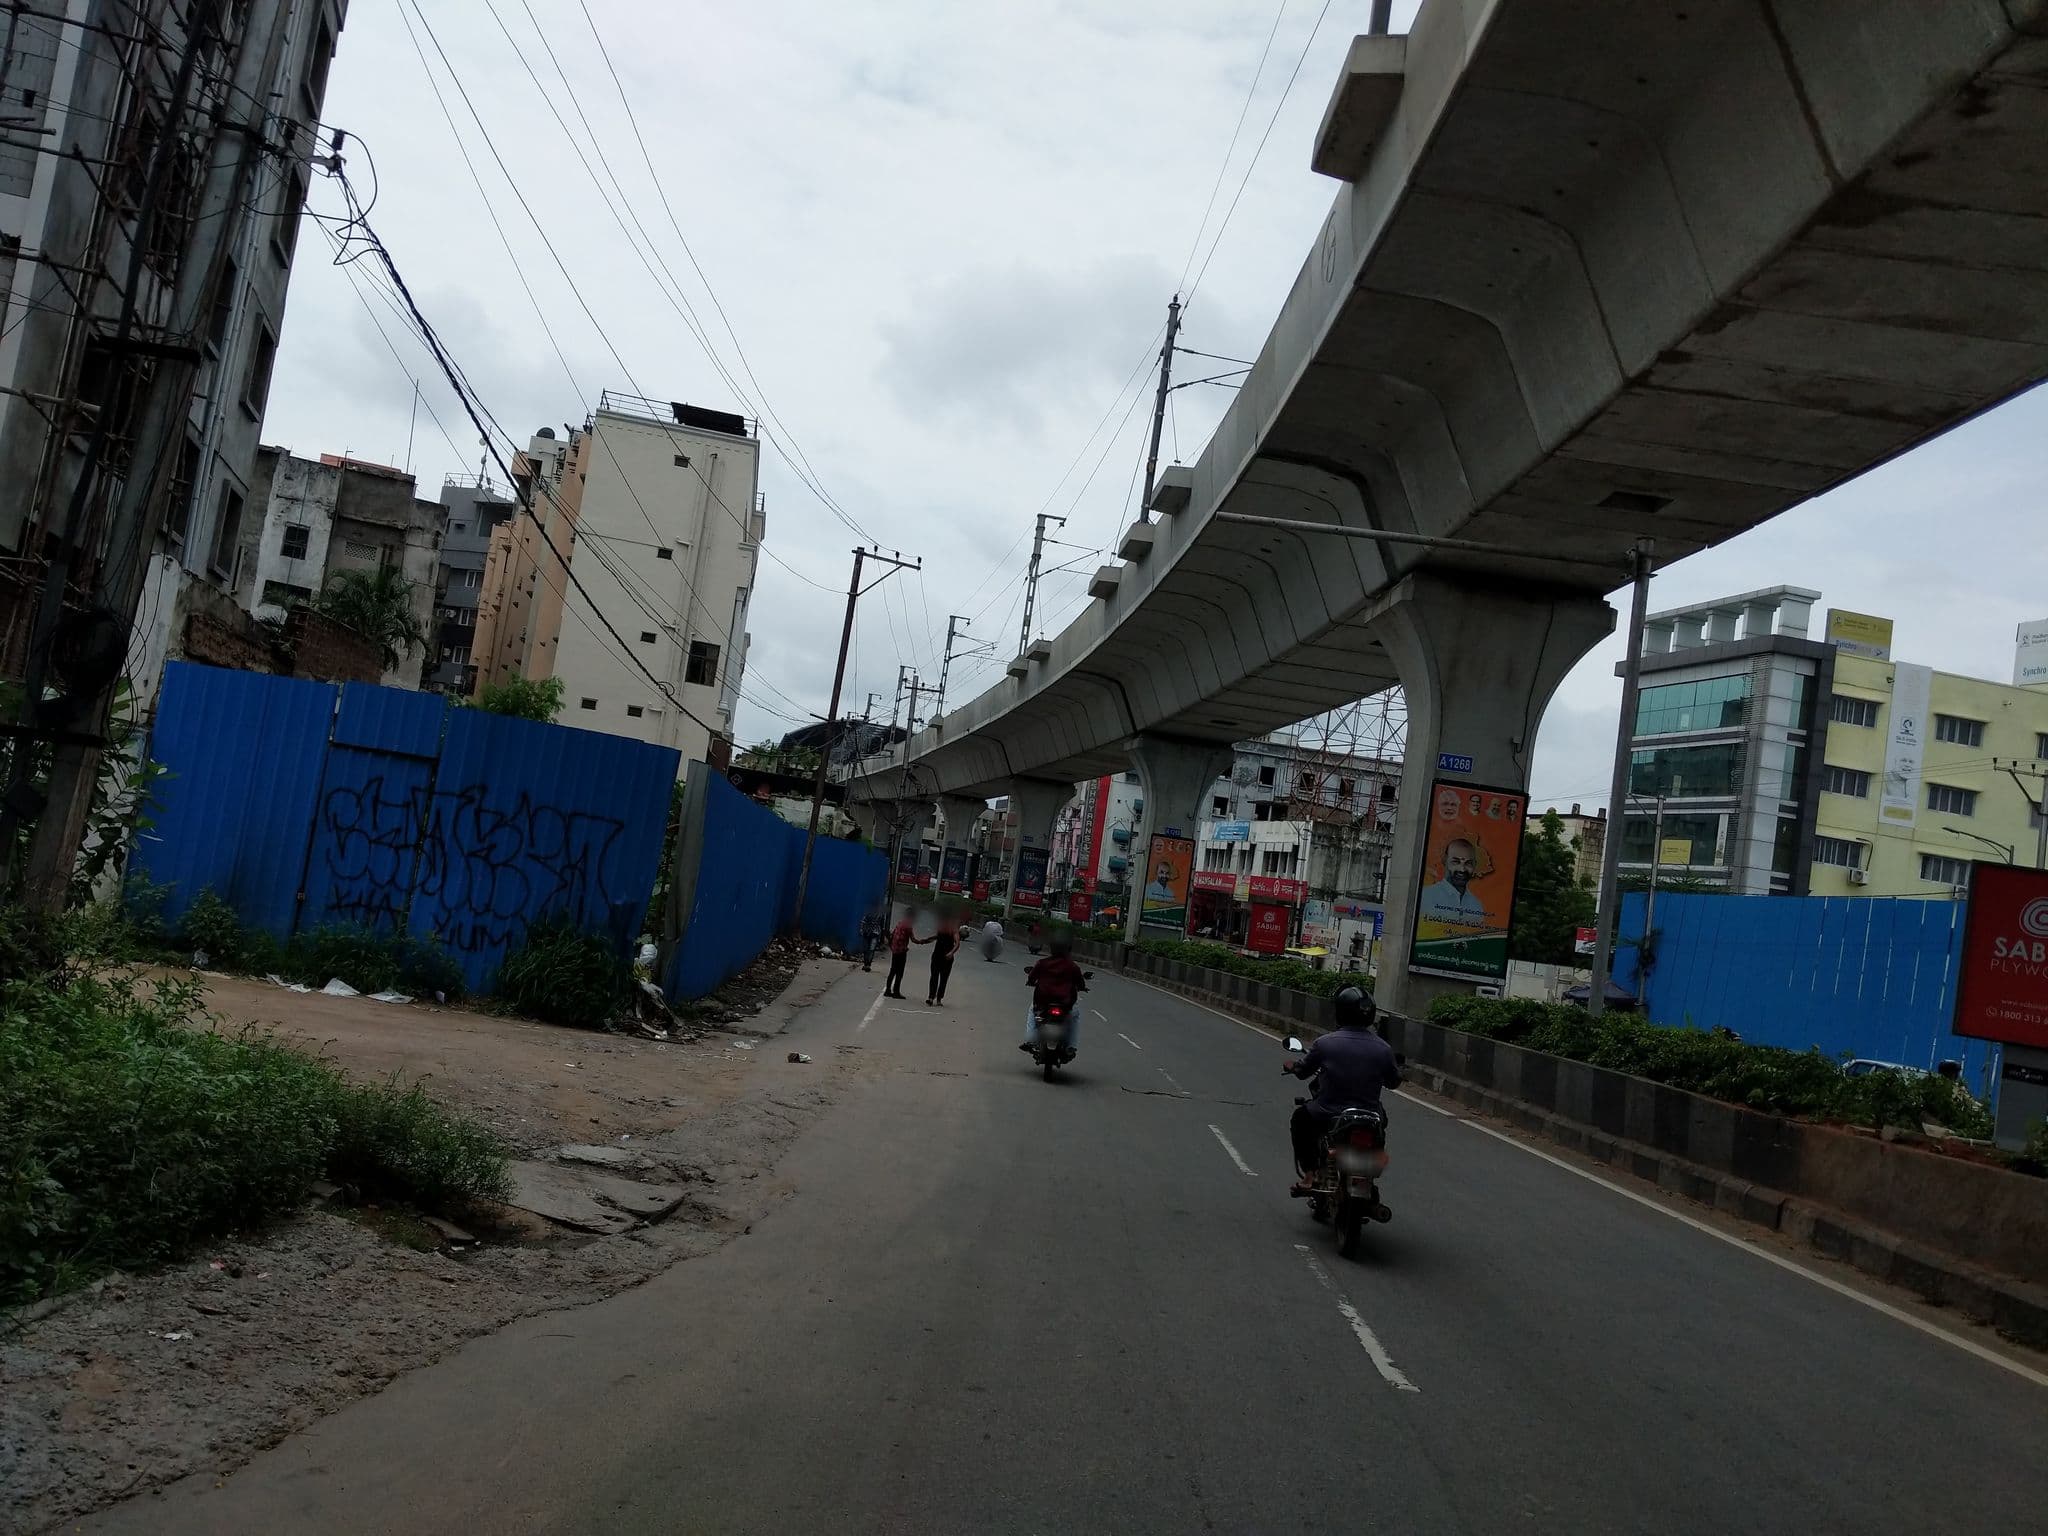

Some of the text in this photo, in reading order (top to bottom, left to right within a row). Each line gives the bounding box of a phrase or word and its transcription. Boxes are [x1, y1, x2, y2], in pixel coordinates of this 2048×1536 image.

[1440, 756, 1471, 770] A 1268
[2000, 1010, 2022, 1020] 1800
